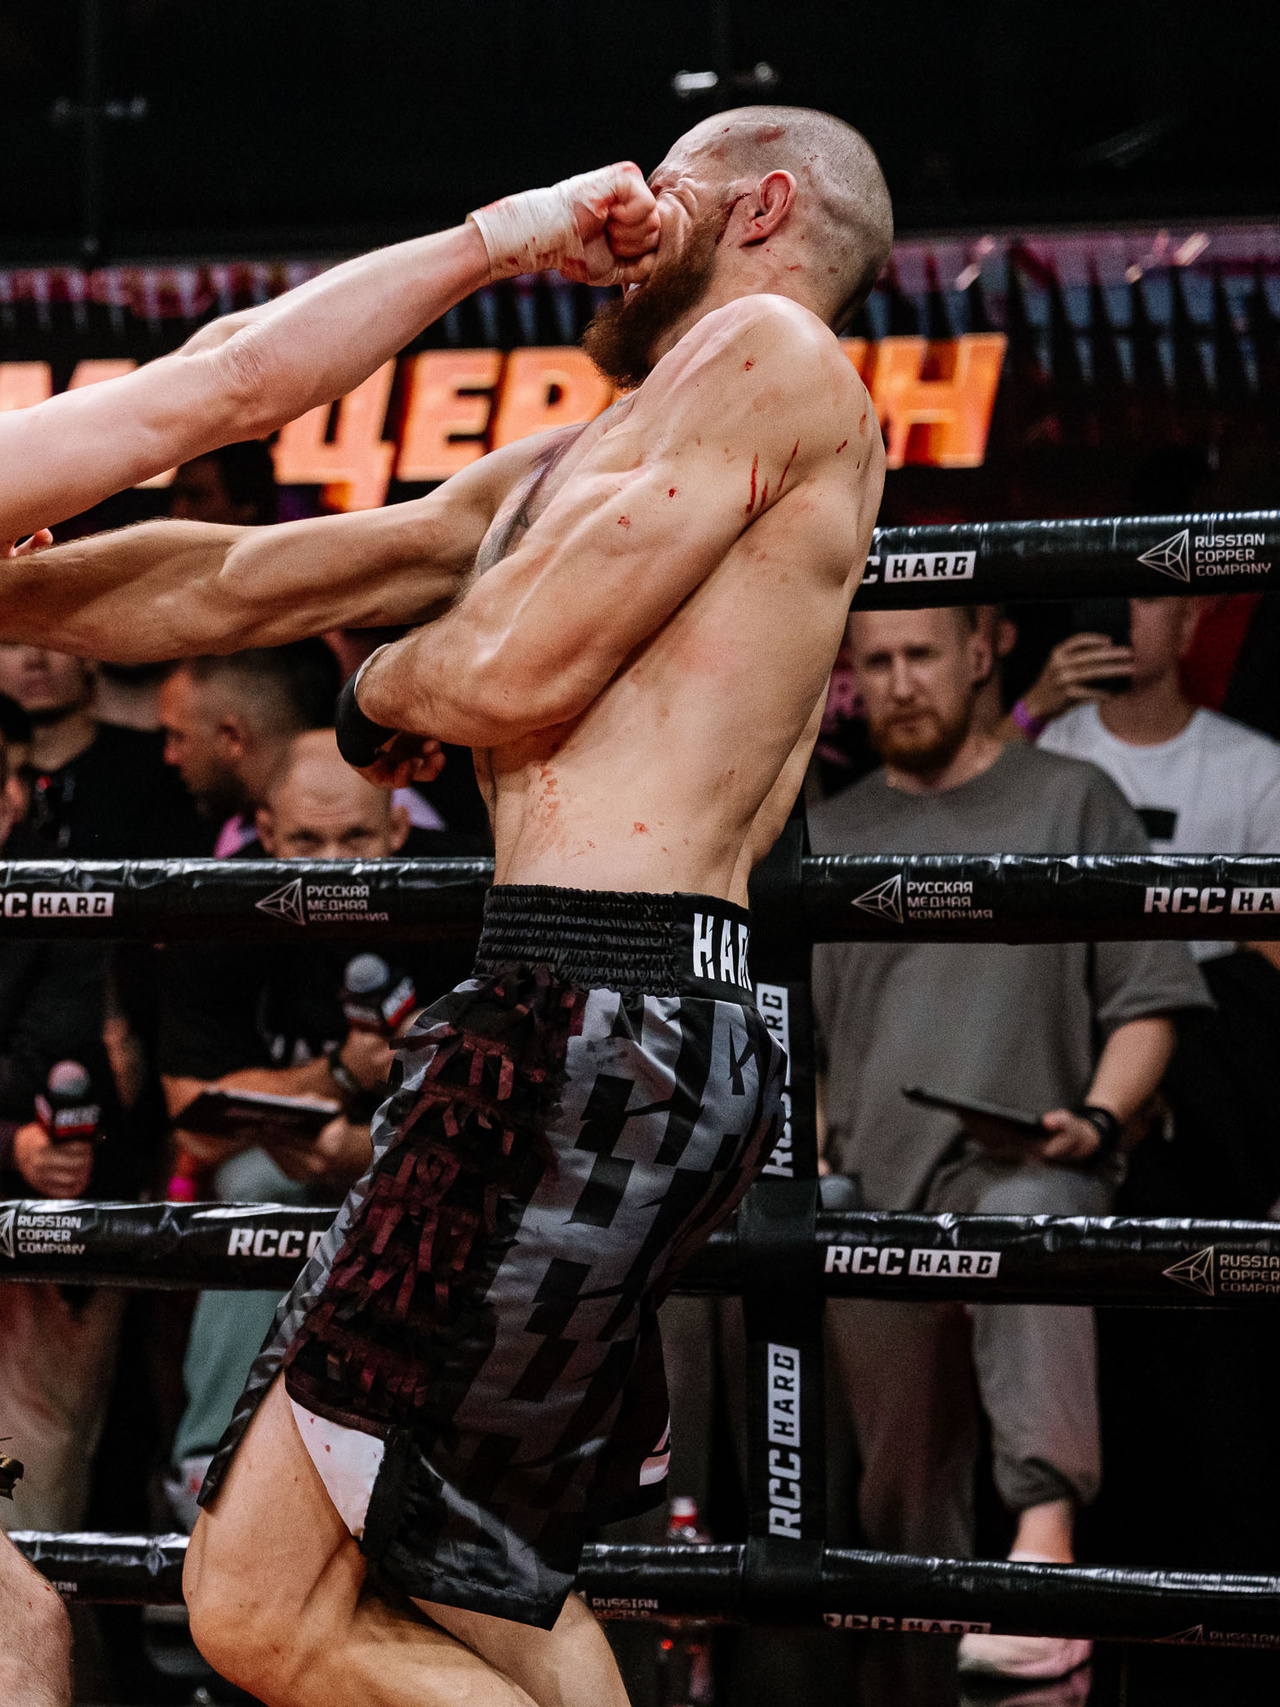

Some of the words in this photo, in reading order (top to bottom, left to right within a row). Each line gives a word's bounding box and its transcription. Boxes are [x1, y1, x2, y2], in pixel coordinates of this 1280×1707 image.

[1194, 533, 1266, 548] RUSSIAN
[1195, 547, 1256, 562] COPPER
[890, 553, 970, 580] HARD
[1195, 562, 1272, 577] COMPANY
[306, 884, 369, 898] РУССКАЯ
[906, 880, 974, 894] РУССКАЯ
[36, 894, 109, 916] HARD
[306, 899, 368, 911] МЕДНАЯ
[906, 895, 972, 908] МЕДНАЯ
[1144, 887, 1226, 914] RCC
[1236, 889, 1280, 912] HA
[308, 911, 389, 922] КОМПАНИЯ
[908, 908, 994, 920] КОМПАНИЯ
[692, 912, 754, 993] HAR
[17, 1215, 81, 1229] RUSSIAN
[18, 1229, 72, 1242] COPPER
[227, 1228, 302, 1257] RCC
[18, 1242, 86, 1255] COMPANY
[824, 1246, 905, 1275] RCC
[917, 1251, 996, 1276] HARD
[1220, 1253, 1280, 1269] RUSSIA
[1220, 1282, 1280, 1294] COMPA
[771, 1350, 797, 1440] HARD
[768, 1449, 802, 1540] RCC
